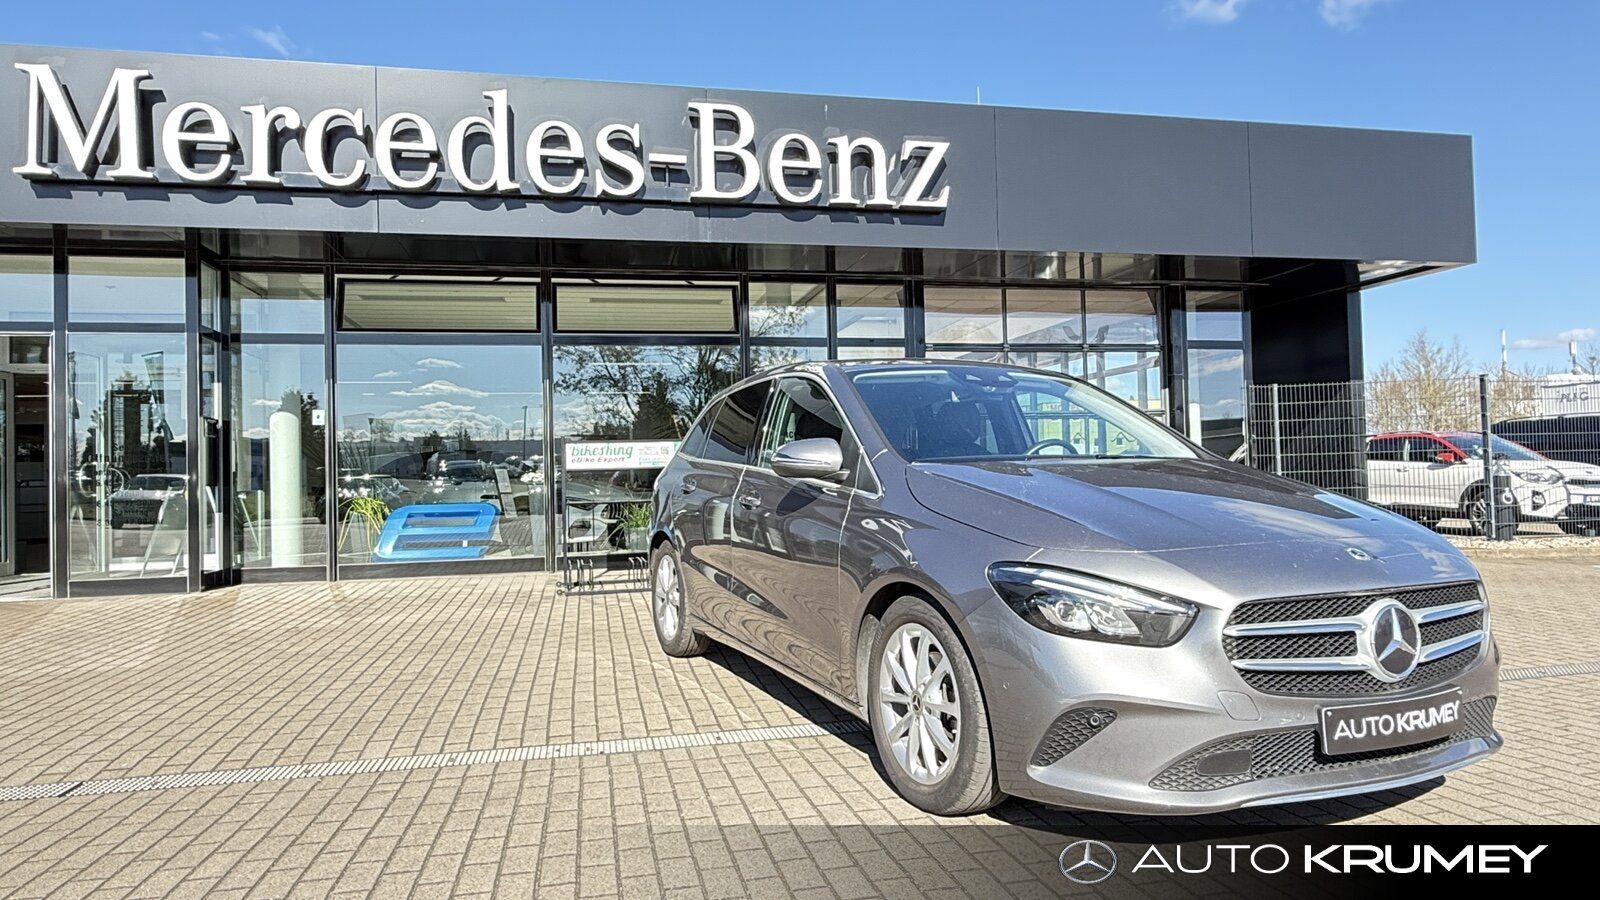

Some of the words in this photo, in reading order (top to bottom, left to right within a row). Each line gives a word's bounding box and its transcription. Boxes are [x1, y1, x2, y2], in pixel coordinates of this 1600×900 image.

[12, 62, 951, 211] Mercedes-Benz
[1333, 714, 1395, 741] AUTO
[1396, 700, 1461, 734] KRUMEY
